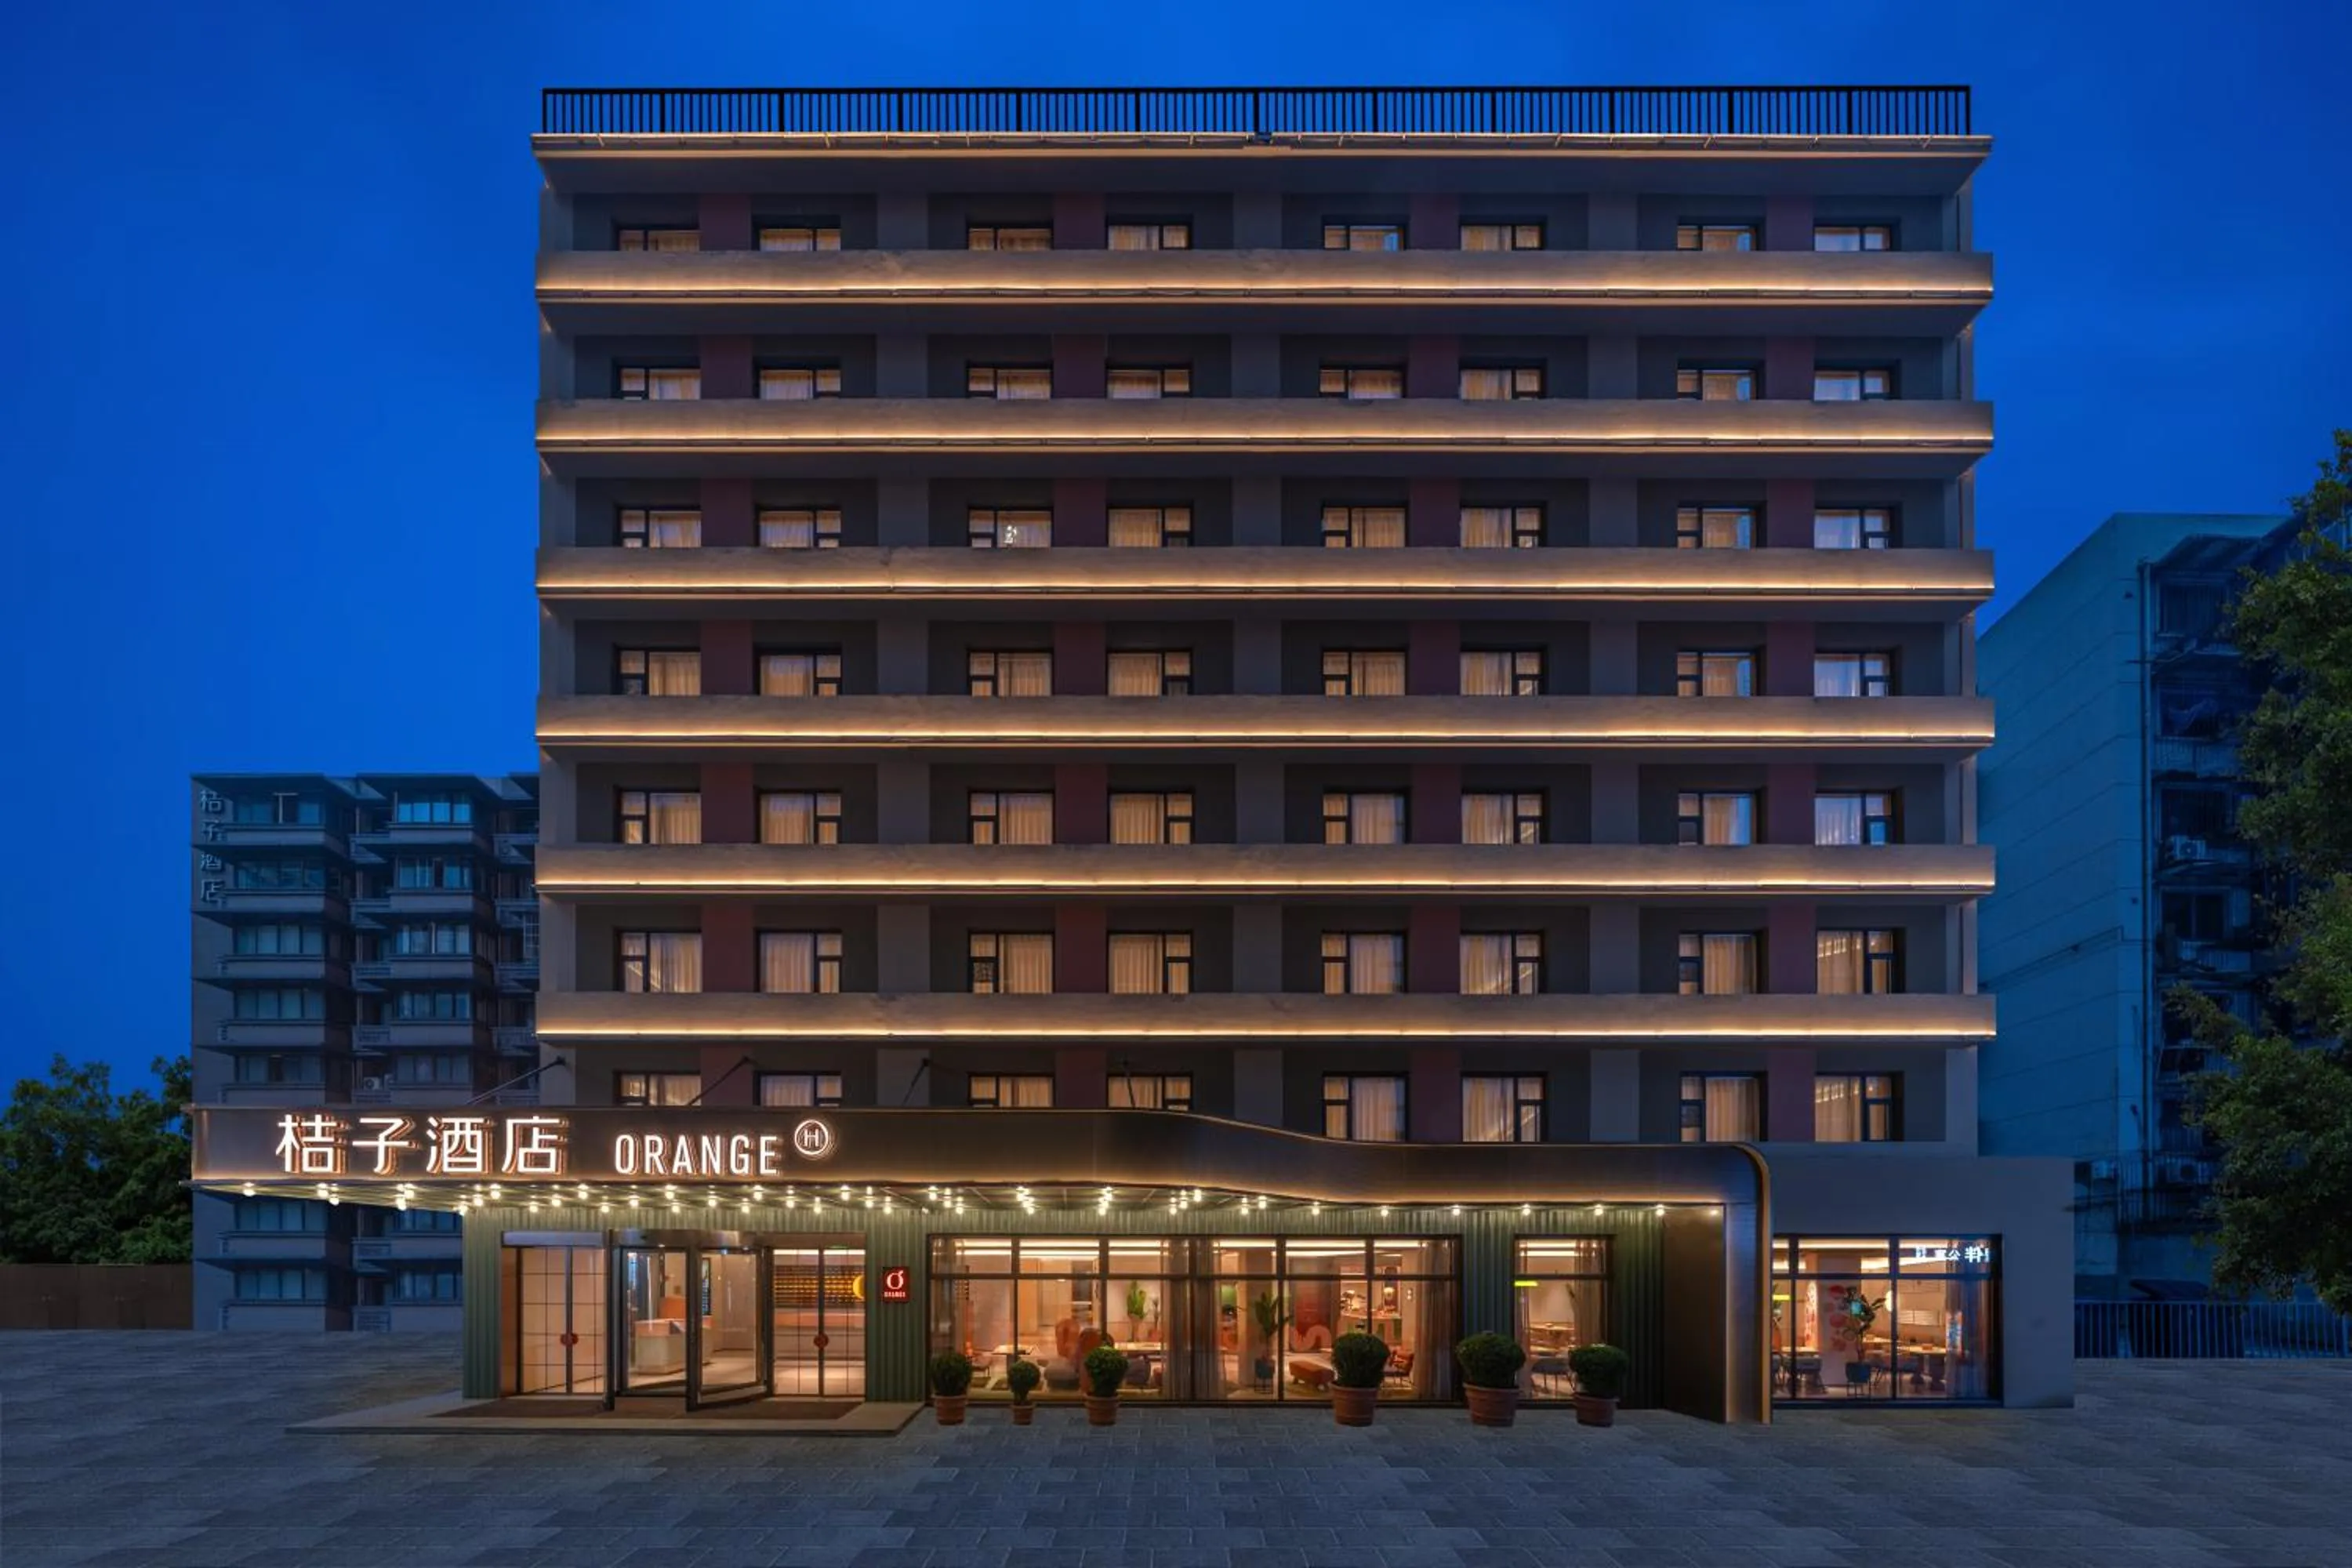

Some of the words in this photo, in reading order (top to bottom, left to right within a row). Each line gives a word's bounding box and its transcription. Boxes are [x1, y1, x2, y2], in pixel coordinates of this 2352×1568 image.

[276, 1114, 561, 1174] 桔子酒店
[615, 1134, 779, 1174] ORANGE
